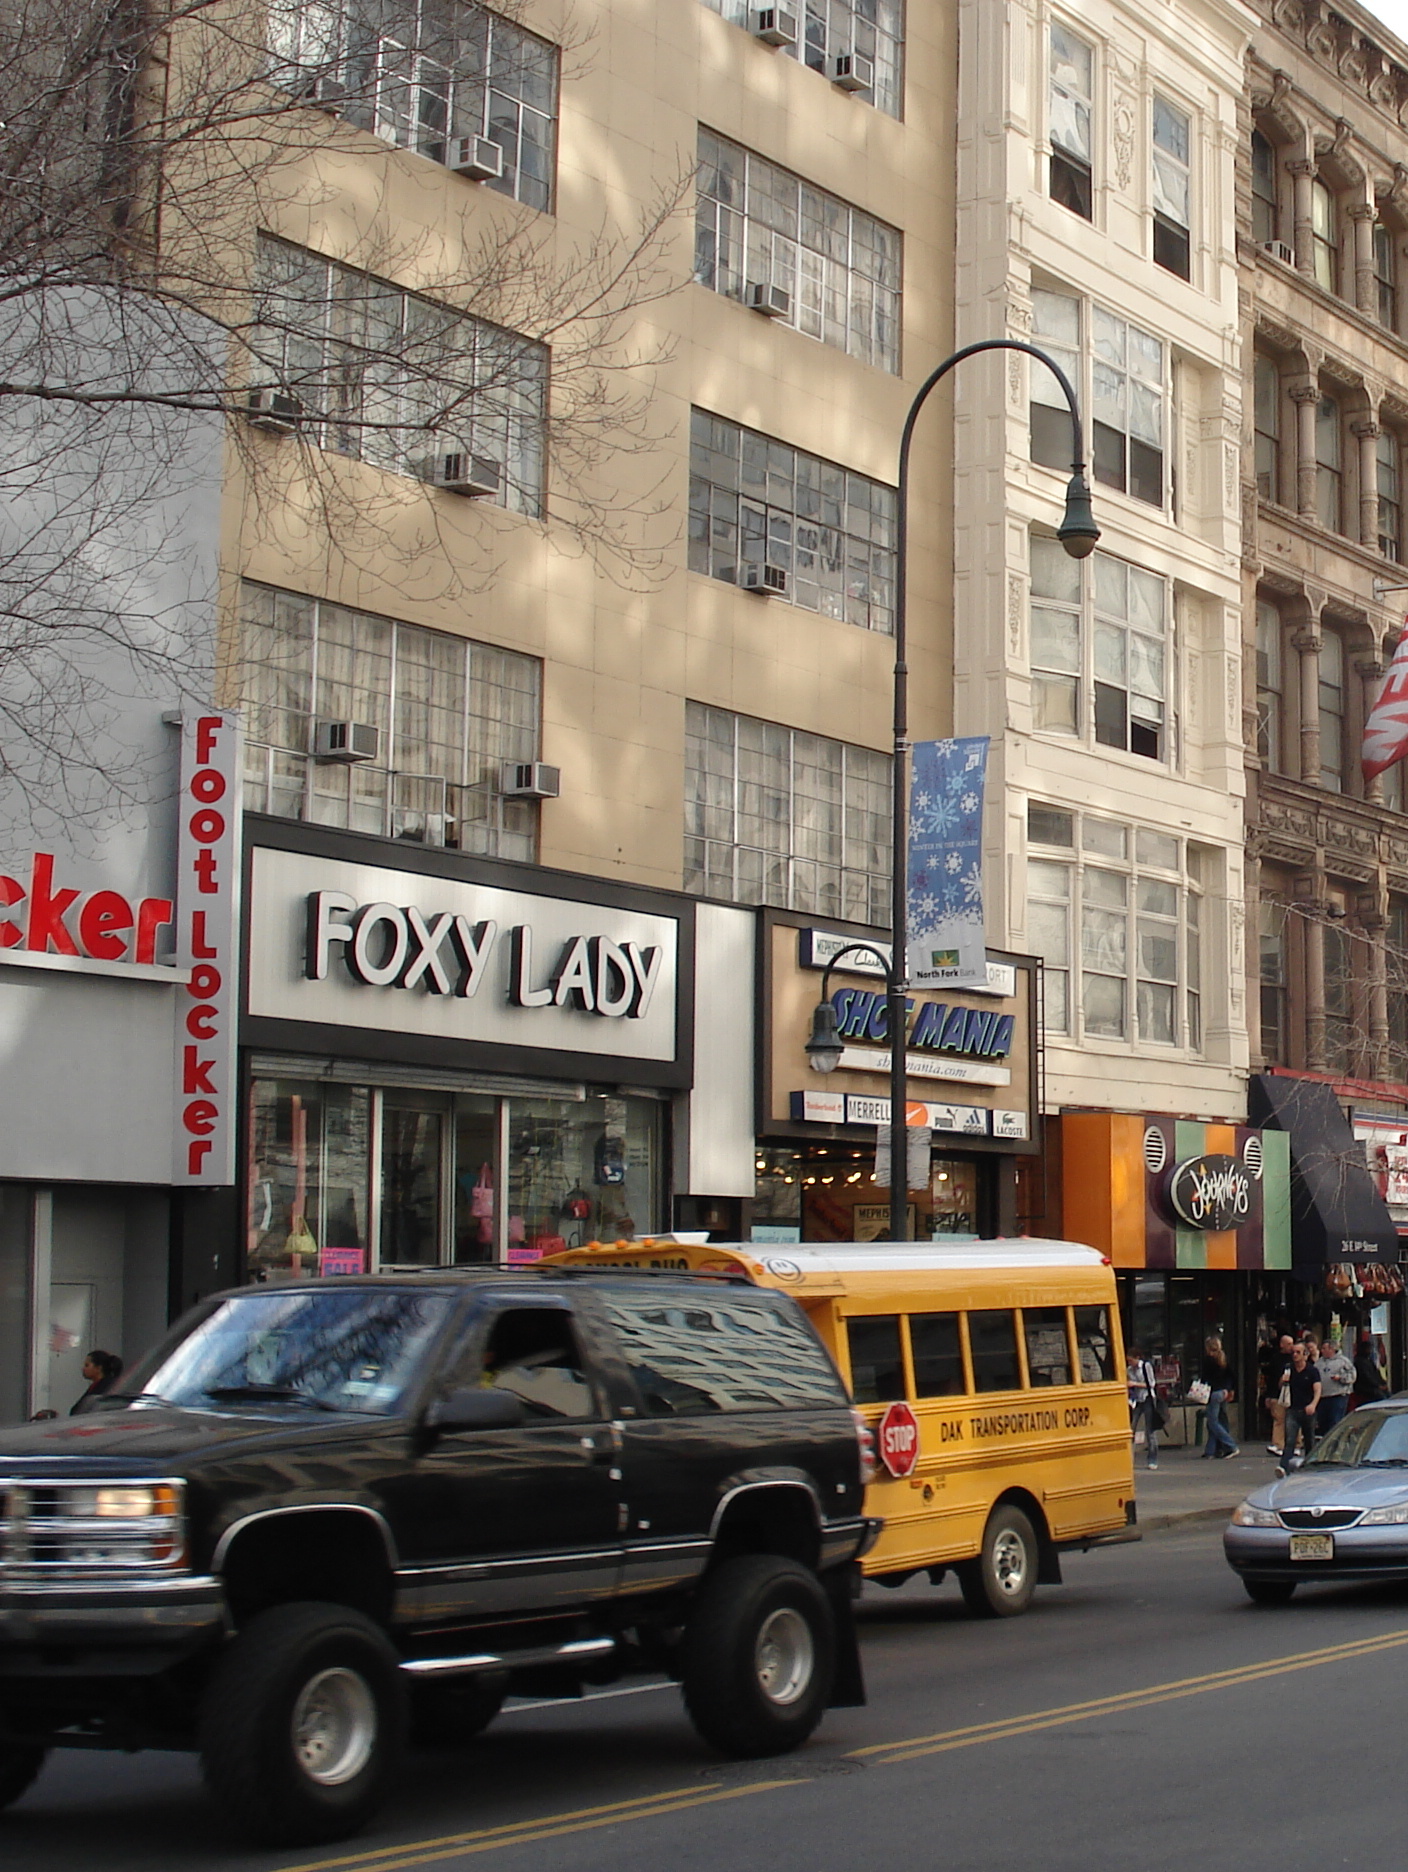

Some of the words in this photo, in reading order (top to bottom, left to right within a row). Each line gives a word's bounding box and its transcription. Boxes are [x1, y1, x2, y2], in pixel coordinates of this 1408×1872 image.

[188, 717, 226, 894] Foot
[305, 889, 497, 998] FOXY
[511, 925, 663, 1019] LADY
[916, 968, 940, 979] North
[941, 966, 959, 978] Fork
[183, 911, 222, 1176] Locker
[910, 1002, 1016, 1058] MANIA
[849, 1100, 892, 1122] MERRELL
[996, 1126, 1024, 1137] LACOSTE
[885, 1425, 916, 1454] STOP
[941, 1421, 964, 1443] DAK
[970, 1410, 1059, 1439] TRANSPORTATION
[1064, 1407, 1094, 1428] CORP.
